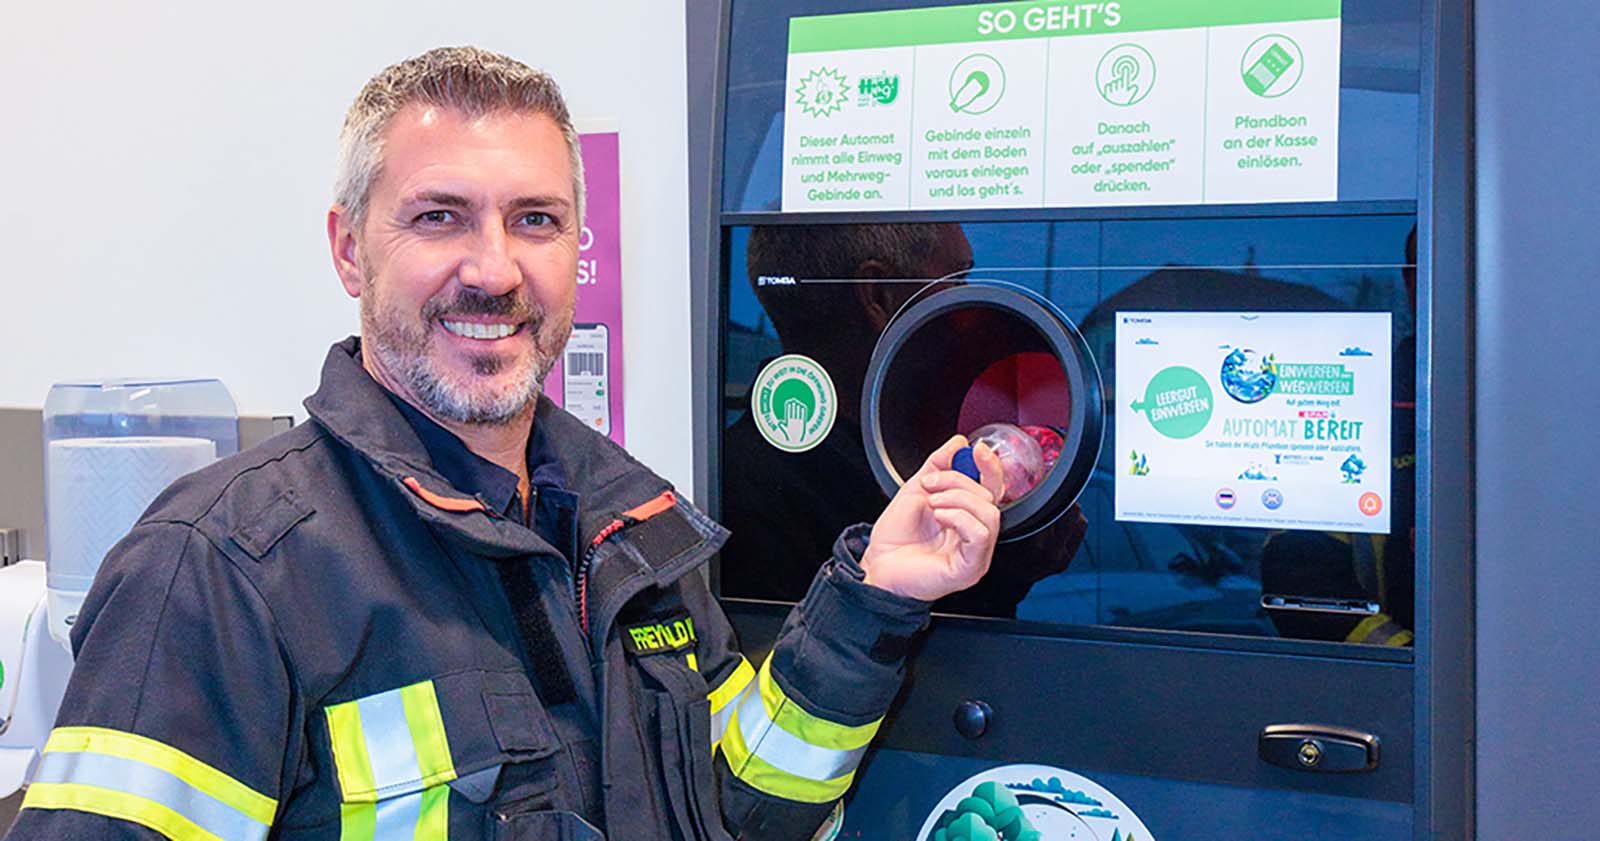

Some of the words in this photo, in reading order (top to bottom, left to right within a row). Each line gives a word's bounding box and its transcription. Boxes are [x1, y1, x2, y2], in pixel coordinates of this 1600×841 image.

[977, 9, 1016, 34] SO
[1023, 2, 1121, 32] GEHT’S
[1097, 121, 1150, 135] Danach
[1234, 115, 1308, 129] Pfandbon
[799, 135, 838, 148] Dieser
[840, 133, 895, 147] Automat
[925, 128, 982, 143] Gebinde
[984, 126, 1031, 140] einzeln
[1223, 137, 1243, 150] an
[1245, 135, 1271, 149] der
[1275, 134, 1318, 148] Kasse
[928, 147, 950, 161] mit
[951, 146, 981, 160] dem
[984, 145, 1027, 159] Boden
[1071, 142, 1093, 156] auf
[791, 152, 830, 167] nimmt
[832, 151, 855, 165] alle
[858, 150, 902, 168] Einweg
[1237, 154, 1302, 169] einlösen.
[925, 166, 969, 179] voraus
[971, 164, 1029, 180] einlegen
[1071, 160, 1102, 175] oder
[800, 170, 825, 184] und
[828, 169, 891, 185] Mehrweg-
[807, 187, 861, 201] Gebinde
[863, 189, 883, 200] an.
[929, 184, 954, 198] und
[956, 183, 975, 197] los
[1093, 179, 1151, 194] drücken.
[1280, 365, 1340, 378] EINWERFEN
[1280, 380, 1350, 393] WEGWERFEN
[1155, 386, 1197, 407] LEERGUT
[1151, 397, 1209, 422] EINWERFEN
[1222, 418, 1298, 438] AUTOMAT
[1304, 419, 1363, 440] BEREIT
